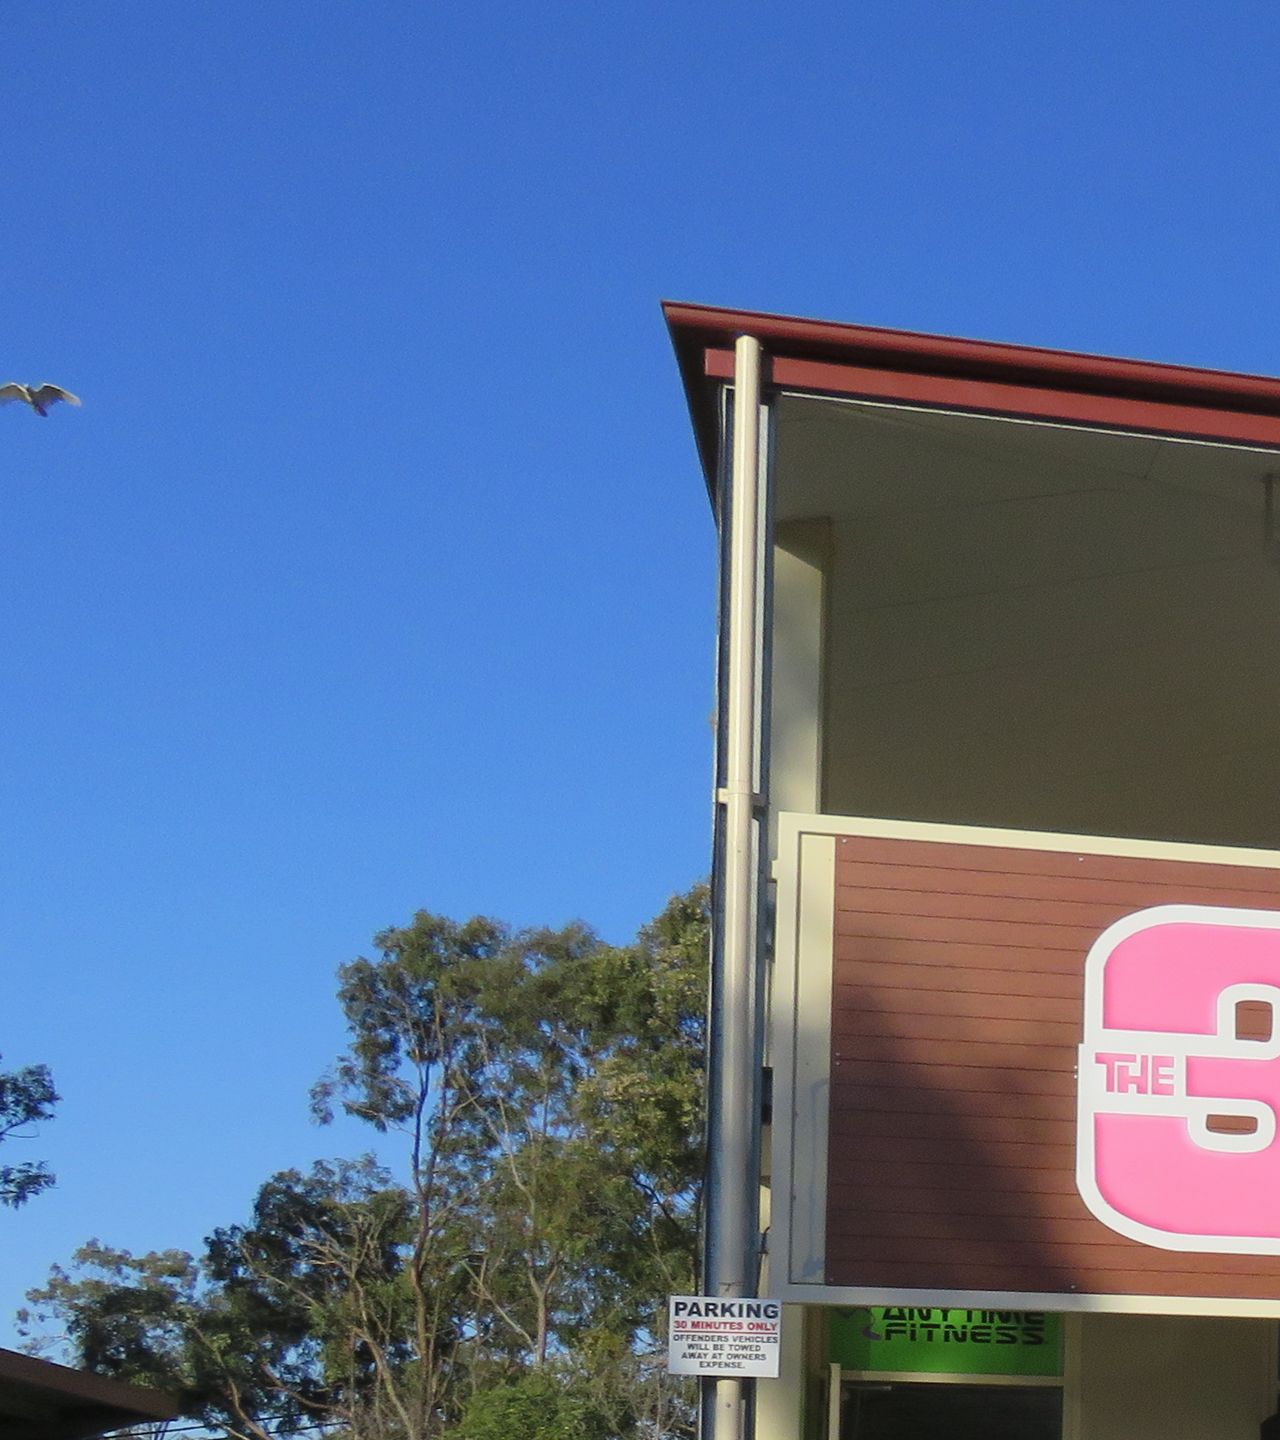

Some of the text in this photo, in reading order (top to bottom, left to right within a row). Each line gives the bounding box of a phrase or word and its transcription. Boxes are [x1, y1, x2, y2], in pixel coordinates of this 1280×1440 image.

[1093, 1051, 1177, 1096] THE
[674, 1301, 779, 1319] PARKING
[673, 1320, 778, 1331] 30 MINUTES ONLY
[673, 1334, 729, 1342] OFFENDERS
[885, 1322, 1045, 1345] FITNESS
[729, 1344, 761, 1352] TOWED
[681, 1352, 707, 1360] AWAY
[699, 1361, 745, 1369] EXPENSE.
